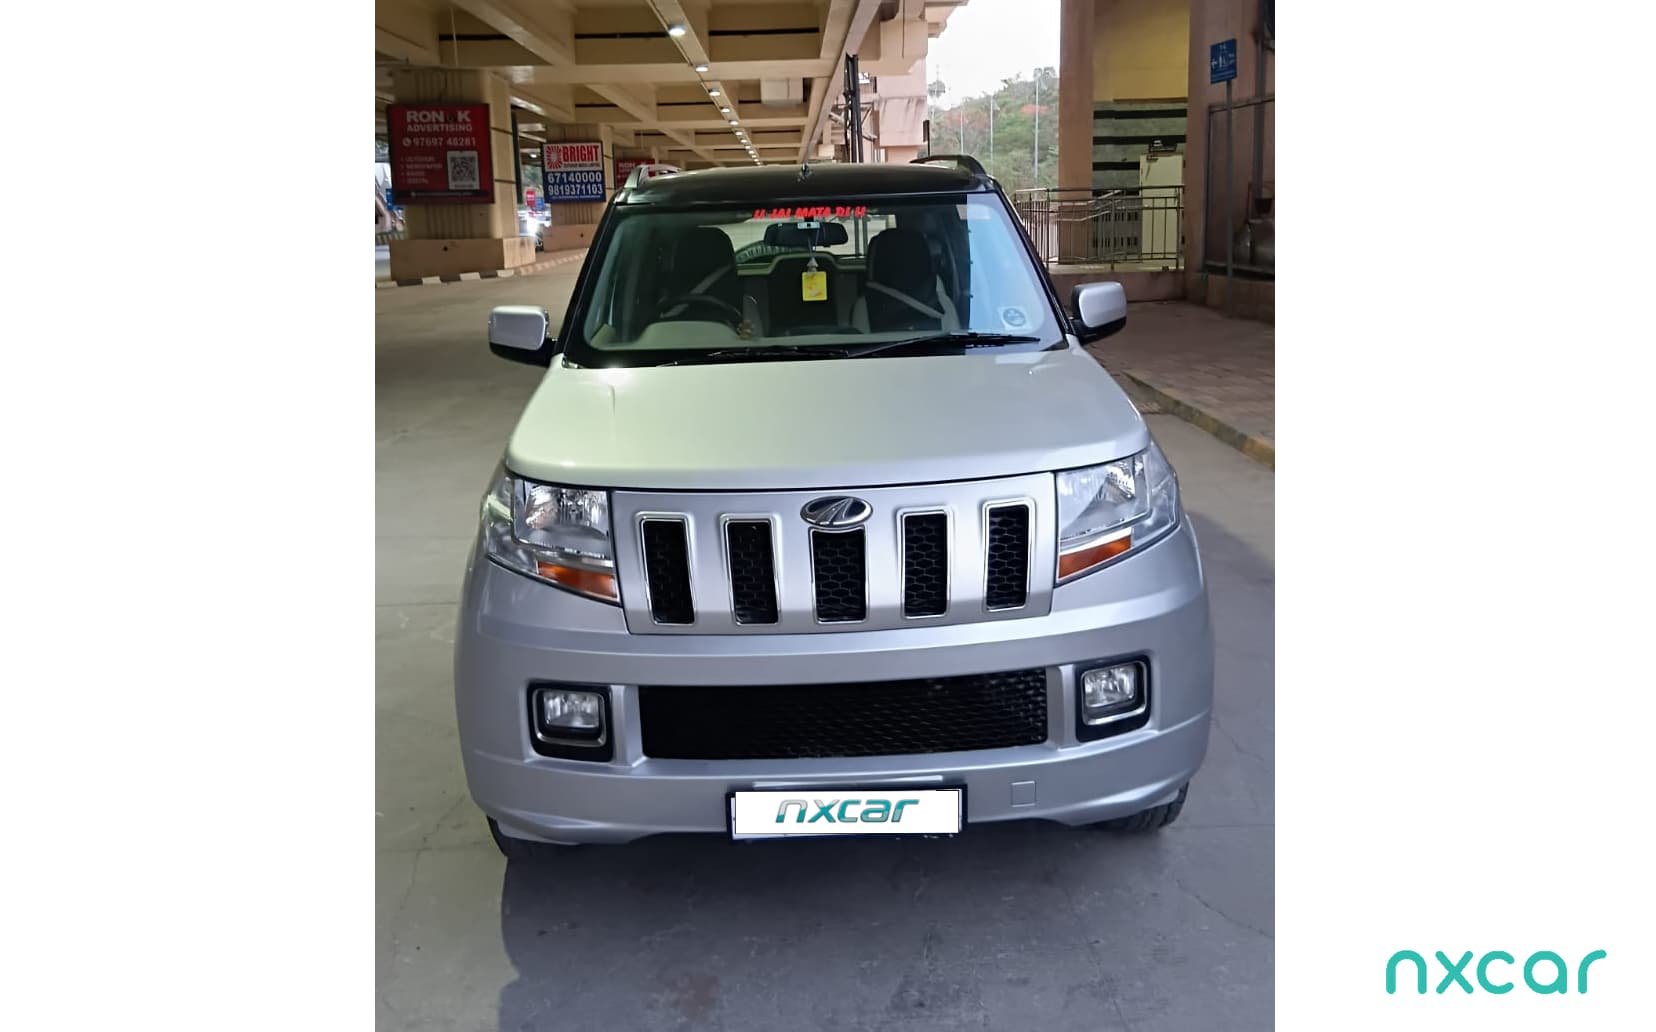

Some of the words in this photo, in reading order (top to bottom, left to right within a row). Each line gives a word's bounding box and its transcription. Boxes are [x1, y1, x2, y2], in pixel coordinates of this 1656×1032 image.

[407, 123, 473, 132] ADVERTISING
[562, 145, 599, 162] BRIGHT
[547, 172, 602, 183] 67140000
[548, 183, 603, 195] 9819371103
[768, 208, 792, 219] JAI
[795, 207, 832, 218] MATA
[835, 206, 850, 217] DI
